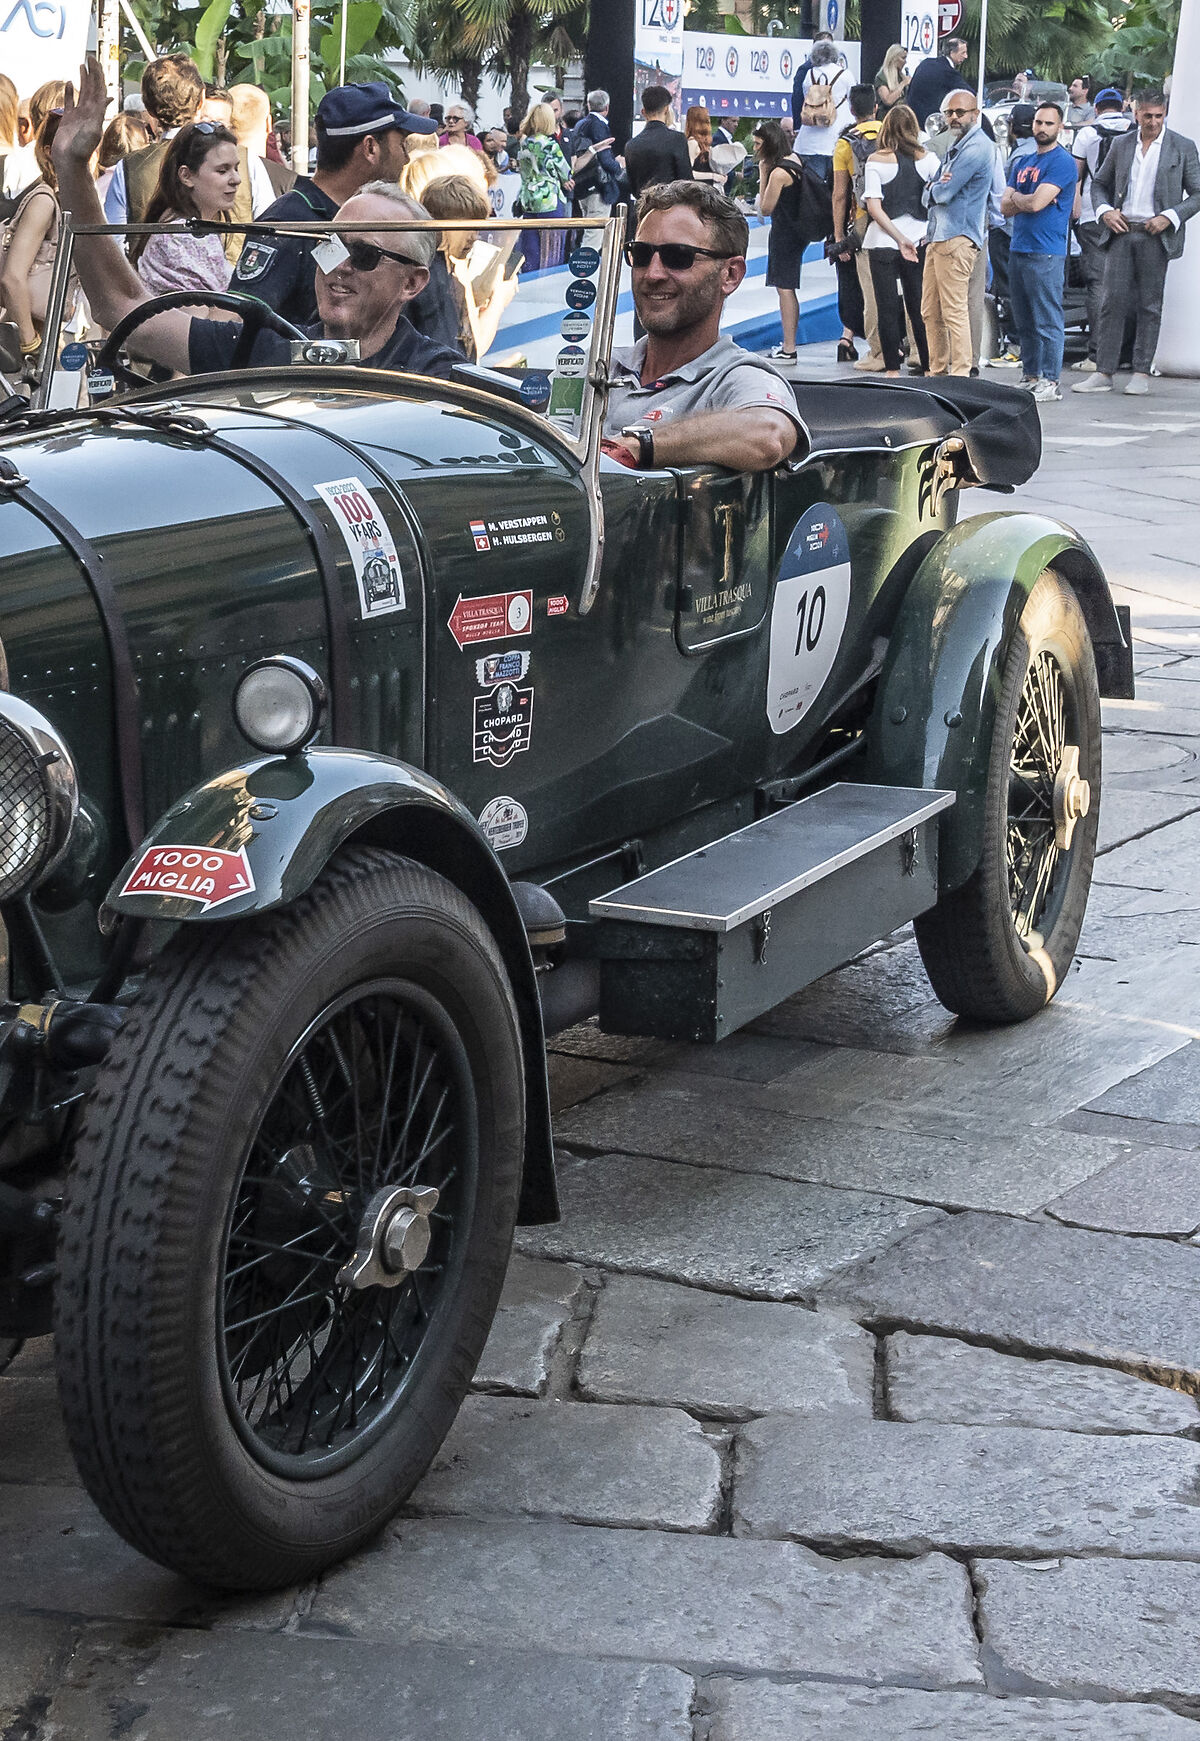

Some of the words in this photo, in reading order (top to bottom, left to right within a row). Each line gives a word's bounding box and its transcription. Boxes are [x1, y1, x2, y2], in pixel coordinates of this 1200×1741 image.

[557, 357, 585, 366] VERIFICATO
[333, 492, 373, 524] 100
[349, 520, 382, 542] YEARS
[488, 522, 498, 531] M.
[499, 515, 548, 531] VERSTAPPEN
[492, 536, 502, 546] H.
[502, 531, 553, 545] HULSBERGEN
[695, 594, 718, 613] VILLA
[719, 583, 752, 607] TRASQUA
[516, 607, 522, 619] 3
[794, 585, 826, 657] 10
[494, 667, 520, 678] MAZZOTTI
[499, 660, 520, 670] FRANCO
[483, 713, 523, 728] CHOPARD
[153, 851, 224, 872] 1000
[132, 871, 216, 896] MIGLIA
